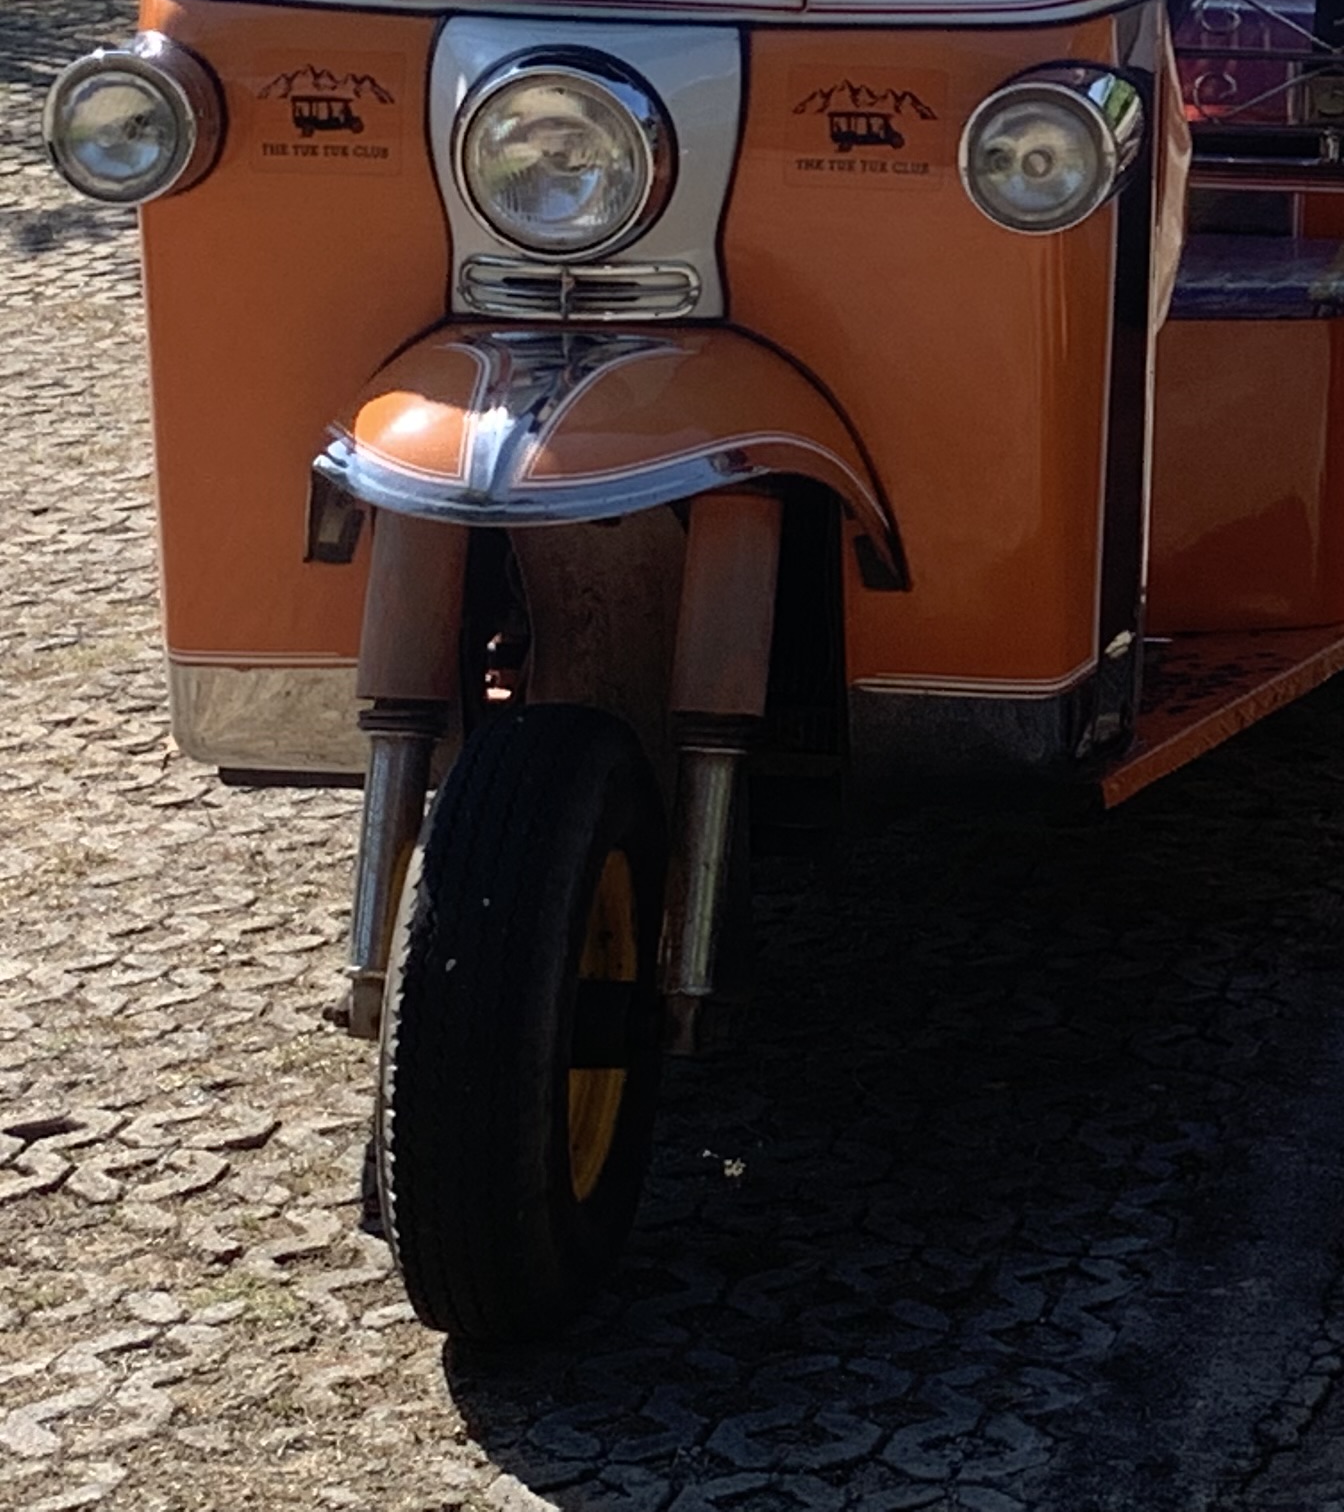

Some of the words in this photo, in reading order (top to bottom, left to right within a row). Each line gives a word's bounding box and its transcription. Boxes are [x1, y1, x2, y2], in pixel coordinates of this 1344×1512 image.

[262, 143, 288, 156] THE
[292, 144, 319, 157] TUK
[323, 145, 349, 158] TUK
[352, 145, 389, 159] CLUB
[796, 159, 824, 171] THE
[829, 159, 856, 172] TUK
[860, 160, 888, 173] TUK
[891, 161, 929, 174] CLUB
